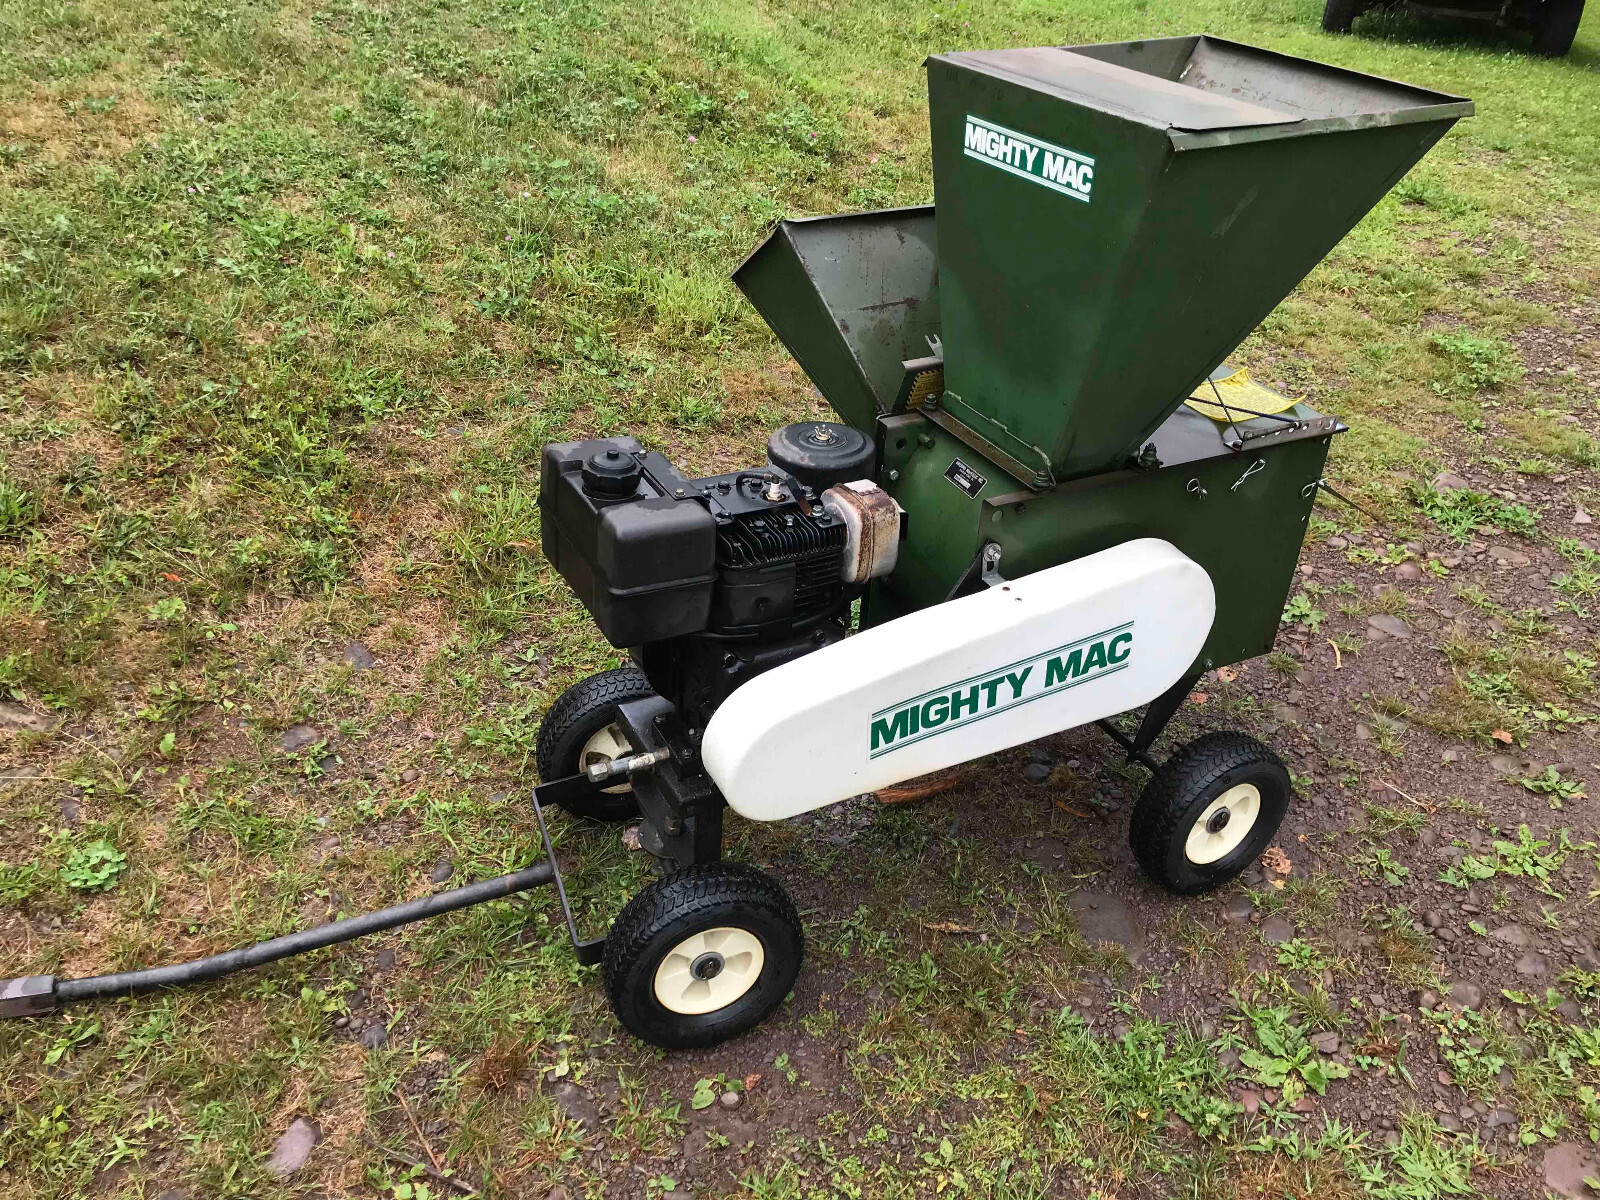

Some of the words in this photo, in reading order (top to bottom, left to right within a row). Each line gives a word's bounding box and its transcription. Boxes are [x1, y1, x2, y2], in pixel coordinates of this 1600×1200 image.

[965, 123, 1039, 172] MIGHTY
[1042, 151, 1093, 193] MAC
[870, 666, 1033, 750] MIGHTY
[1044, 632, 1133, 688] MAC
